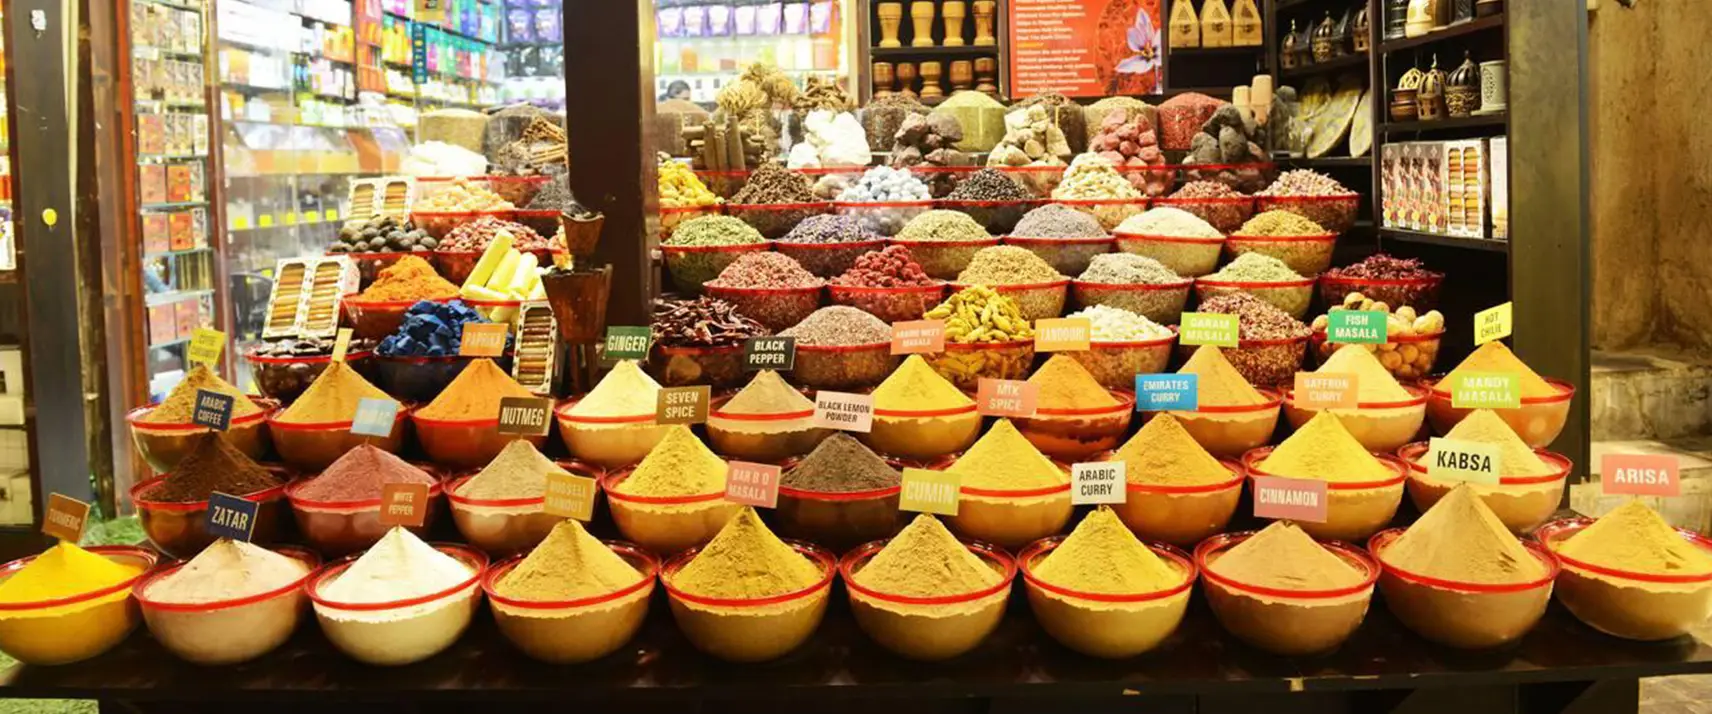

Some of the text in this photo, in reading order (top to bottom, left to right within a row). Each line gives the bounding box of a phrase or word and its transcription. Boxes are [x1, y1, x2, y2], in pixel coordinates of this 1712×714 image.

[1190, 317, 1230, 329] GARAM
[1345, 315, 1368, 326] FISH
[1485, 311, 1499, 324] HOT
[1186, 329, 1232, 342] MASALA
[1335, 327, 1379, 339] MASALA
[607, 335, 647, 352] GINGER
[754, 340, 786, 351] BLACK
[750, 353, 785, 364] PEPPER
[1143, 380, 1189, 391] EMIRATES
[1463, 376, 1510, 389] MANDY
[997, 383, 1019, 396] MIX
[1308, 390, 1343, 402] CURRY
[1458, 390, 1512, 402] MASALA
[201, 395, 227, 411] ARABIC
[666, 391, 699, 404] SEVEN
[1151, 392, 1181, 403] CURRY
[818, 400, 870, 414] BLACK LEMON
[988, 398, 1023, 411] SPICE
[197, 409, 223, 426] COFFEE
[501, 406, 545, 426] NUTMEG
[665, 405, 695, 418] SPICE
[825, 412, 858, 423] POWDER
[1437, 450, 1492, 473] KABSA
[1079, 469, 1116, 481] ARABIC
[1614, 468, 1670, 485] ARISA
[728, 483, 767, 501] MASALA
[907, 480, 954, 504] CUMIN
[1080, 483, 1114, 496] CURRY
[1259, 487, 1319, 507] CINNAMON
[388, 504, 414, 516] PEPPER
[211, 506, 248, 531] ZATAR
